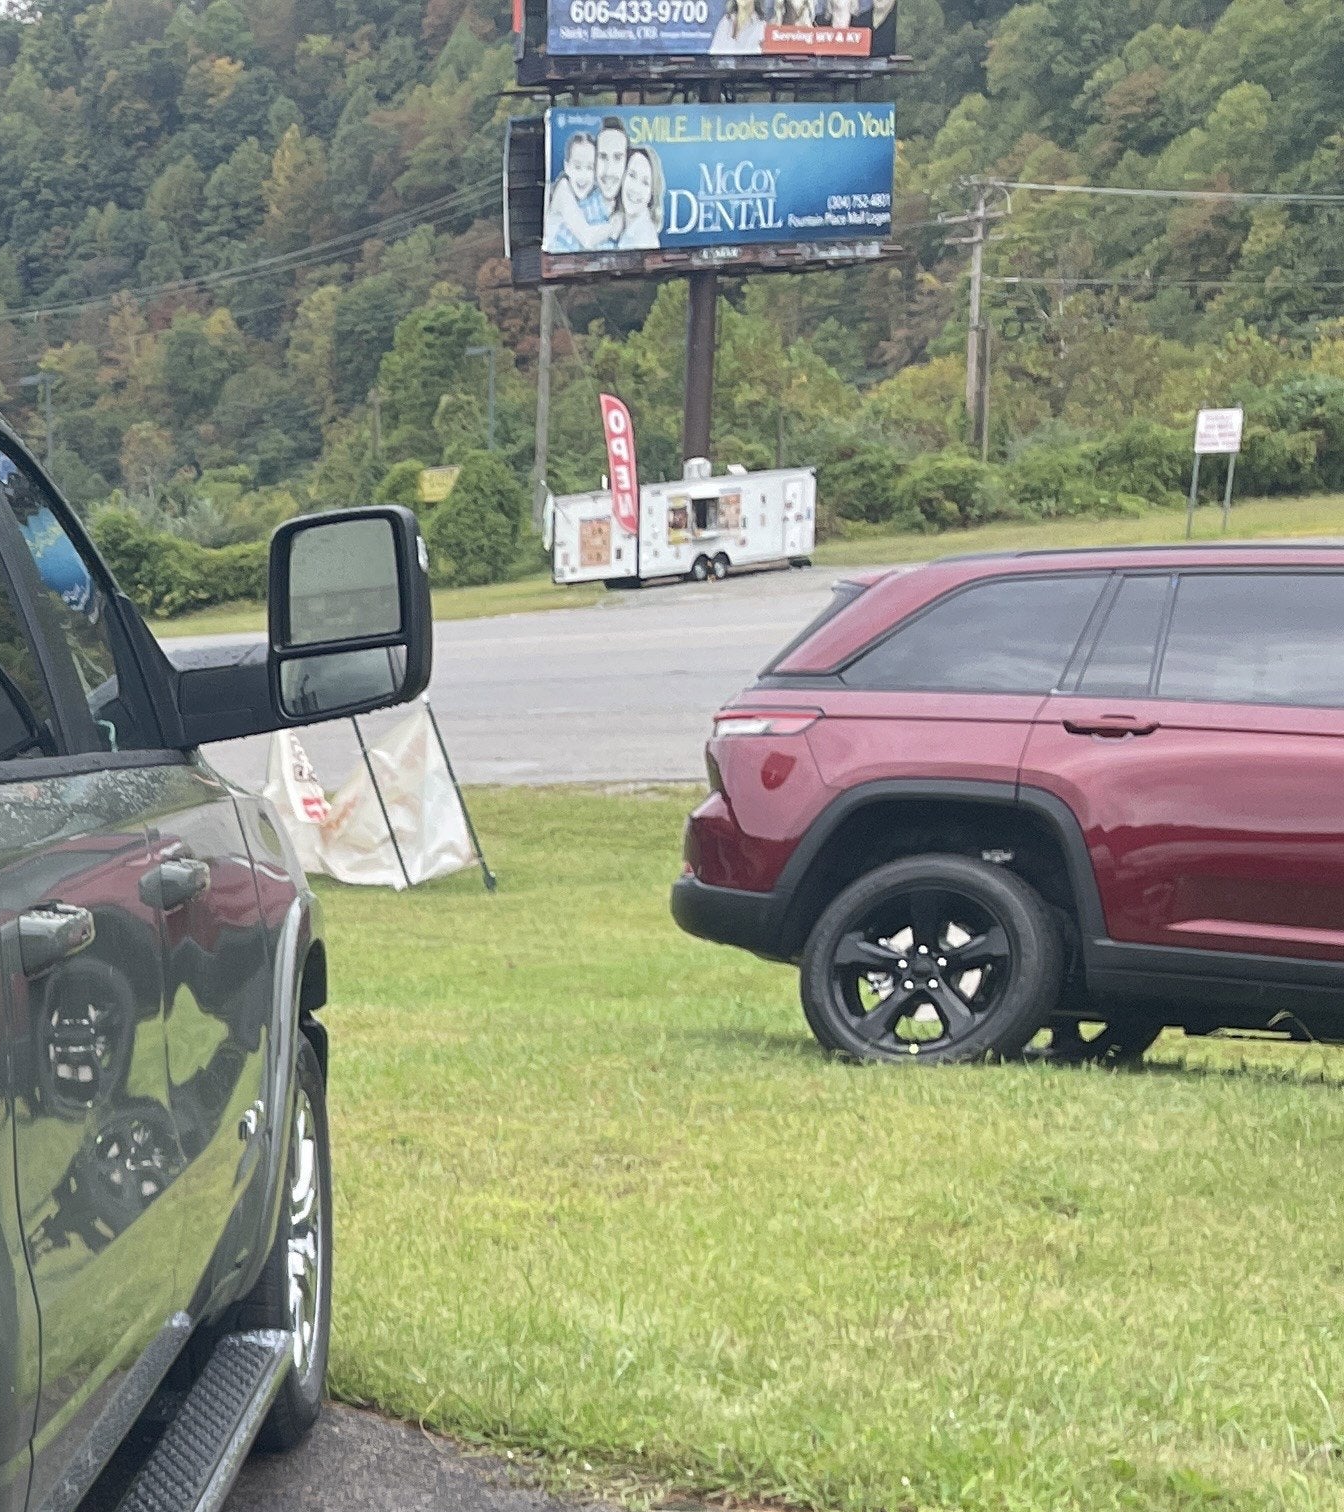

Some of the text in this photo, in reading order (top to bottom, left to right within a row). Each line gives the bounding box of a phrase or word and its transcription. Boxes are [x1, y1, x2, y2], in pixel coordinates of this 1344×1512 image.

[570, 0, 709, 23] 606-433-9700
[772, 29, 813, 44] Serving
[835, 31, 845, 43] &
[716, 112, 769, 142] Looks
[772, 111, 824, 140] Good
[828, 111, 856, 139] On
[857, 110, 895, 138] You!
[666, 189, 783, 235] DENTAL
